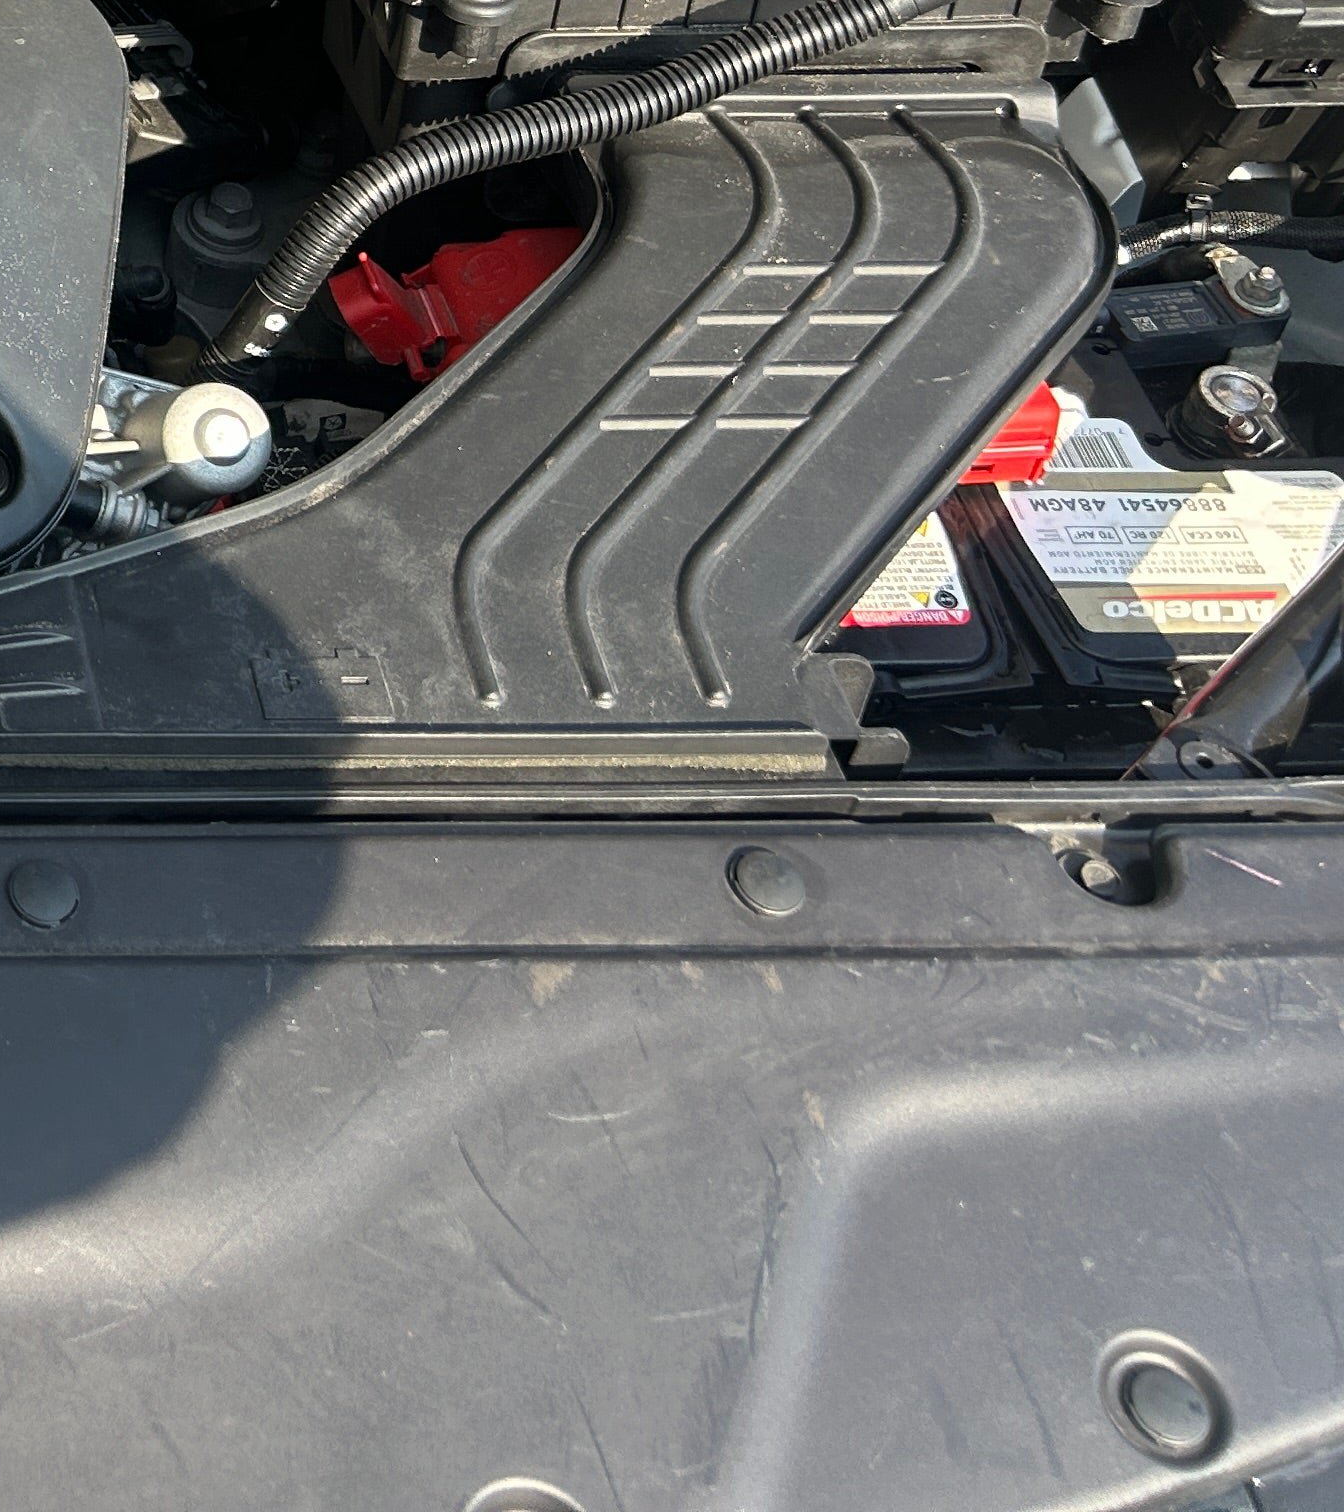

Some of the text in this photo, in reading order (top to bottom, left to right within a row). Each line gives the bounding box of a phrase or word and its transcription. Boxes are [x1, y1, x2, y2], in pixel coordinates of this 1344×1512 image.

[1028, 498, 1228, 512] 88864541 48AGM
[1098, 531, 1116, 539] 70
[1129, 531, 1147, 539] RC
[1185, 531, 1213, 539] CCA
[1052, 567, 1108, 575] BATTERY
[1102, 599, 1276, 624] ACDelco
